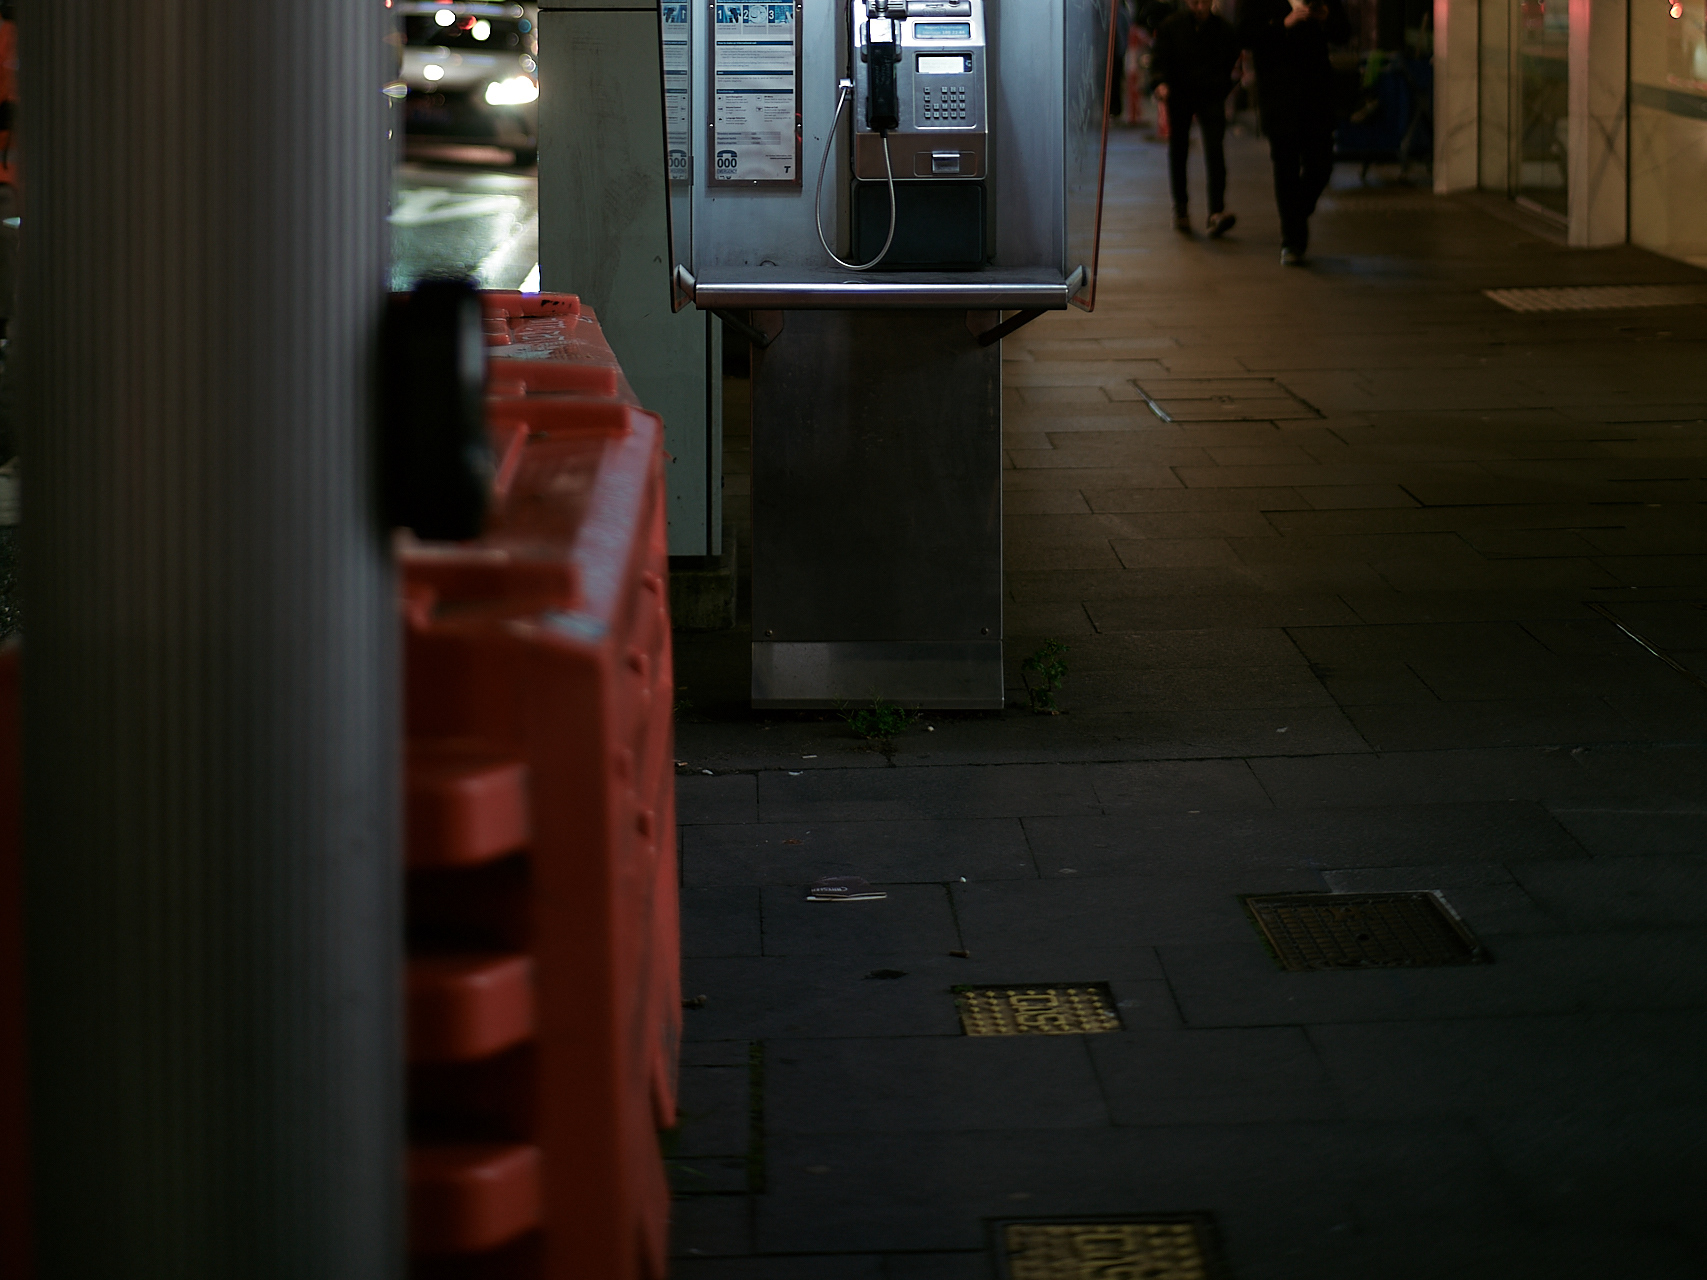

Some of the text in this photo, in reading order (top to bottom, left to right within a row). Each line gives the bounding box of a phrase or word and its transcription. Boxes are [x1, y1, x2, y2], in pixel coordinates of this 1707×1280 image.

[718, 10, 722, 19] 1
[743, 10, 749, 20] 2
[768, 10, 774, 20] 3
[716, 157, 738, 168] 000
